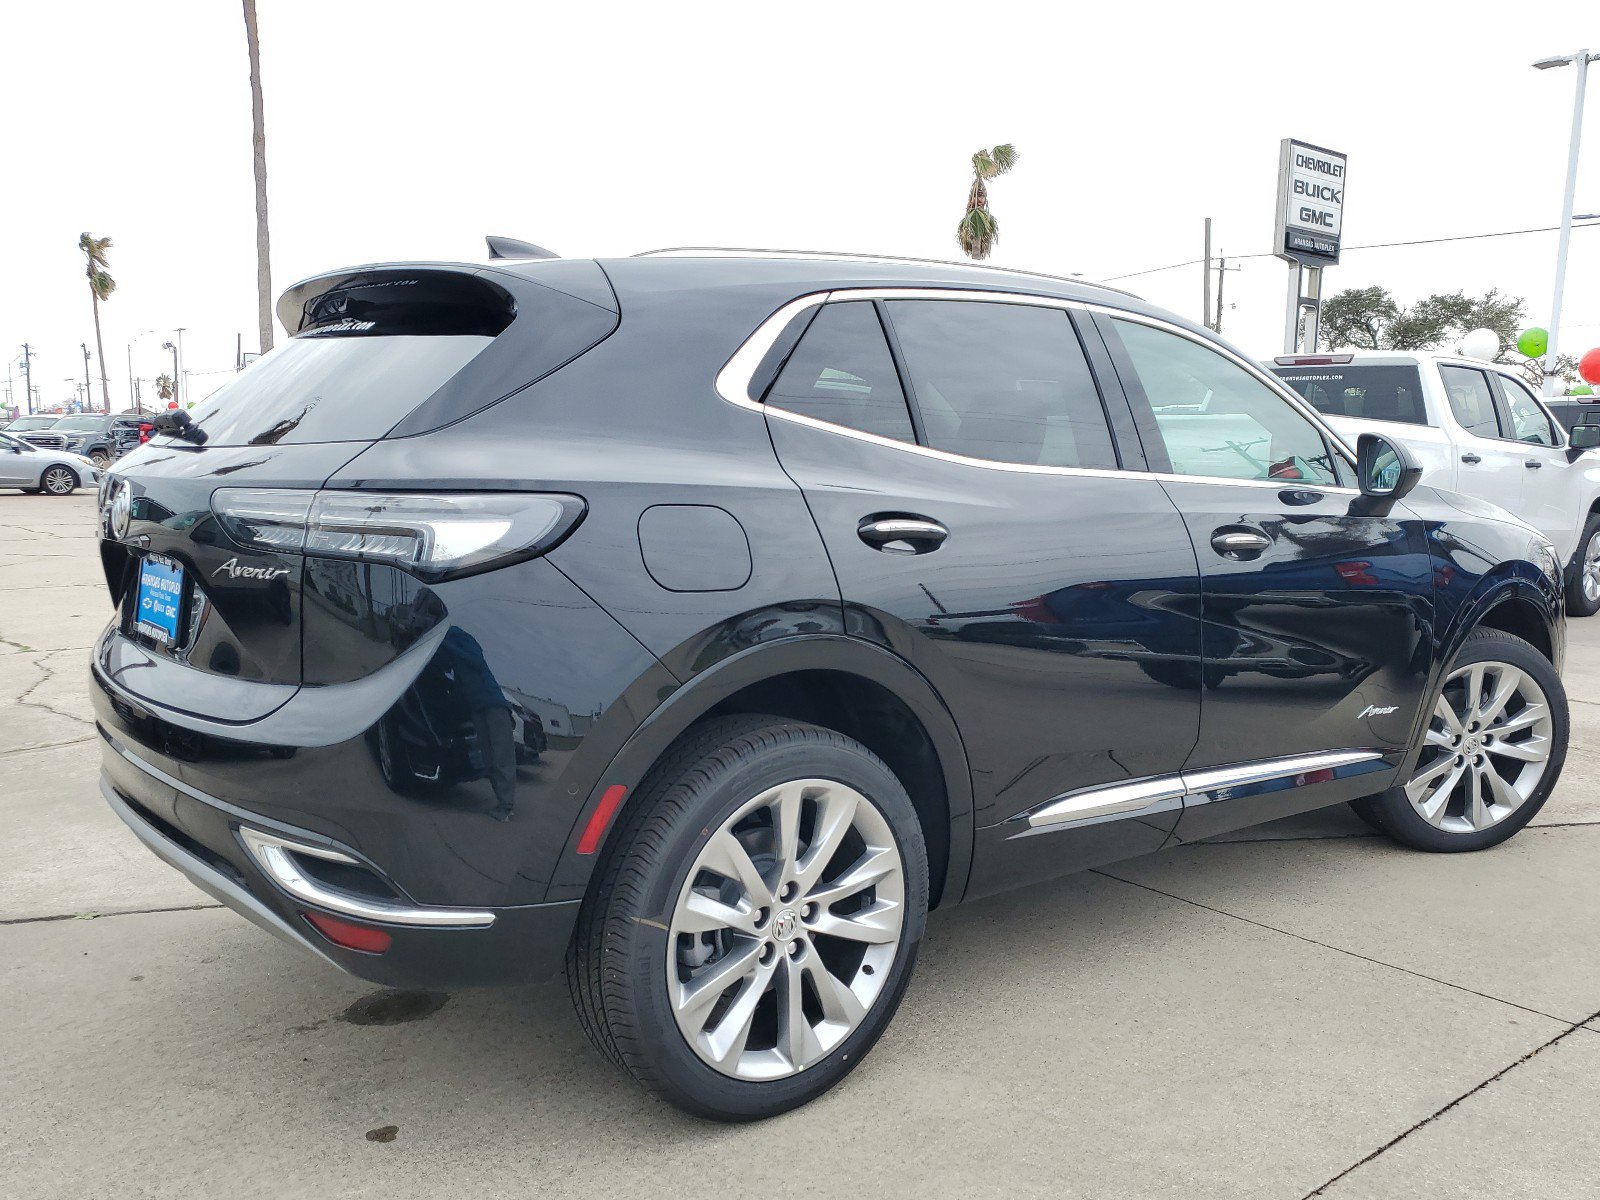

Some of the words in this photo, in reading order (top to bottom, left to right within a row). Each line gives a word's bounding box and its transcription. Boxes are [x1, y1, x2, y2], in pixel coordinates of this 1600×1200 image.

[1296, 154, 1343, 177] CHEVROLET
[1294, 179, 1341, 204] BUICK
[1300, 207, 1333, 227] GMC
[1294, 238, 1313, 248] ARANSAS
[1314, 241, 1335, 252] AUTOPLEX
[211, 558, 291, 580] Avenir
[1356, 704, 1399, 719] Avenir
